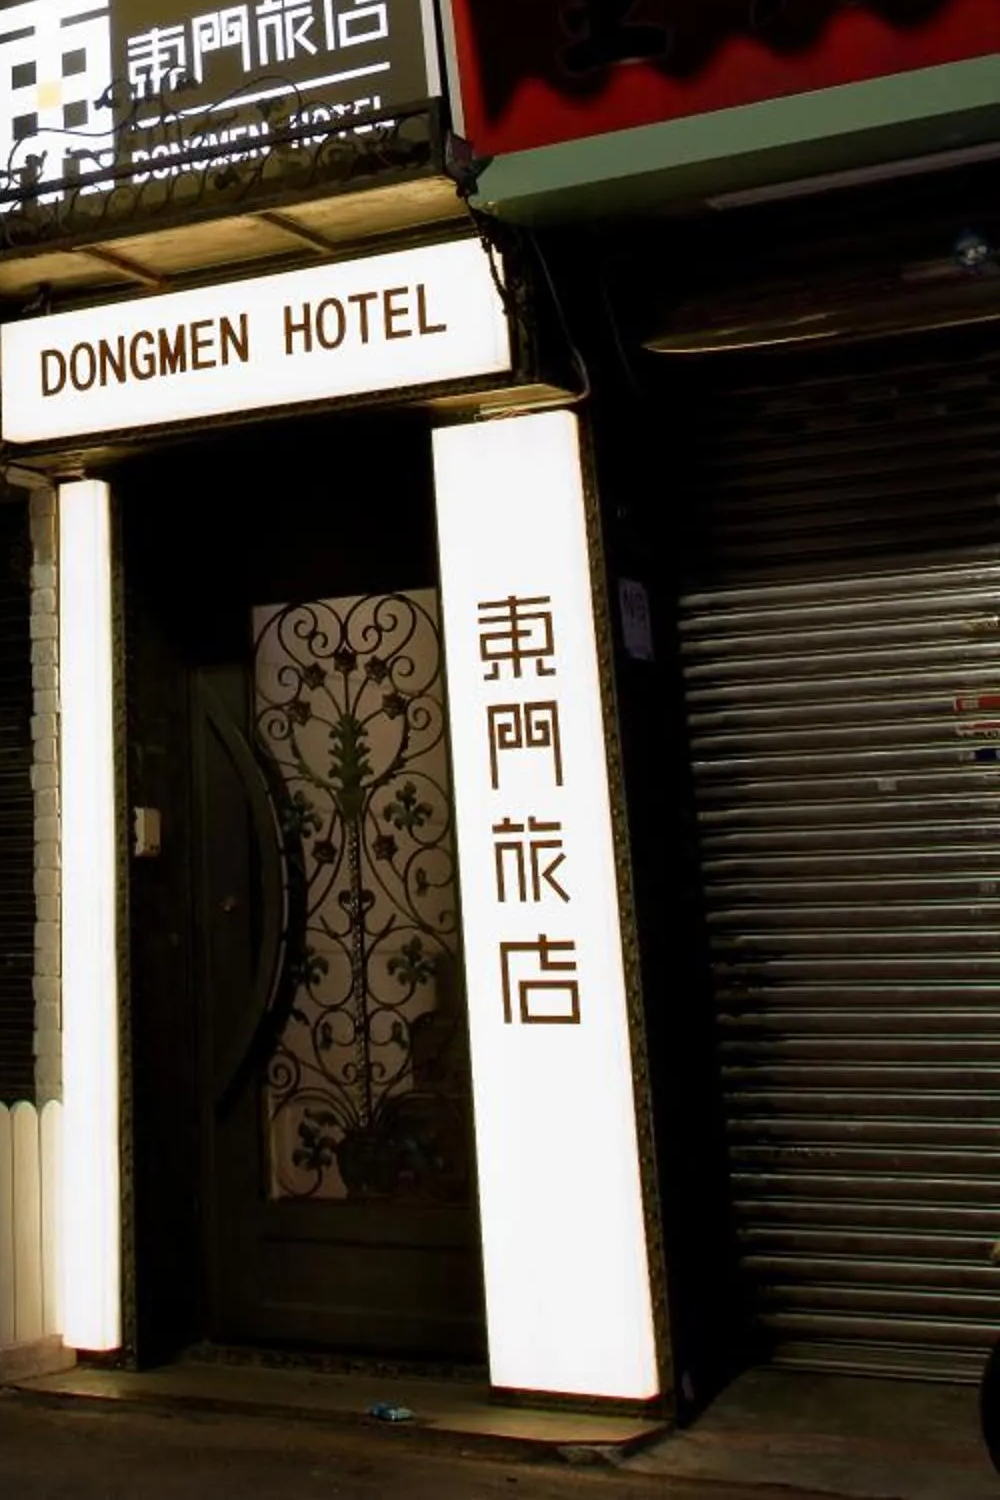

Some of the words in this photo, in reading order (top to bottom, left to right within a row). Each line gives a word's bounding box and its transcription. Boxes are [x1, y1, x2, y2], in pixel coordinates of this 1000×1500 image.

[40, 313, 250, 397] DONGMEN
[283, 283, 448, 356] HOTEL
[477, 595, 581, 1025] 東門旅店
